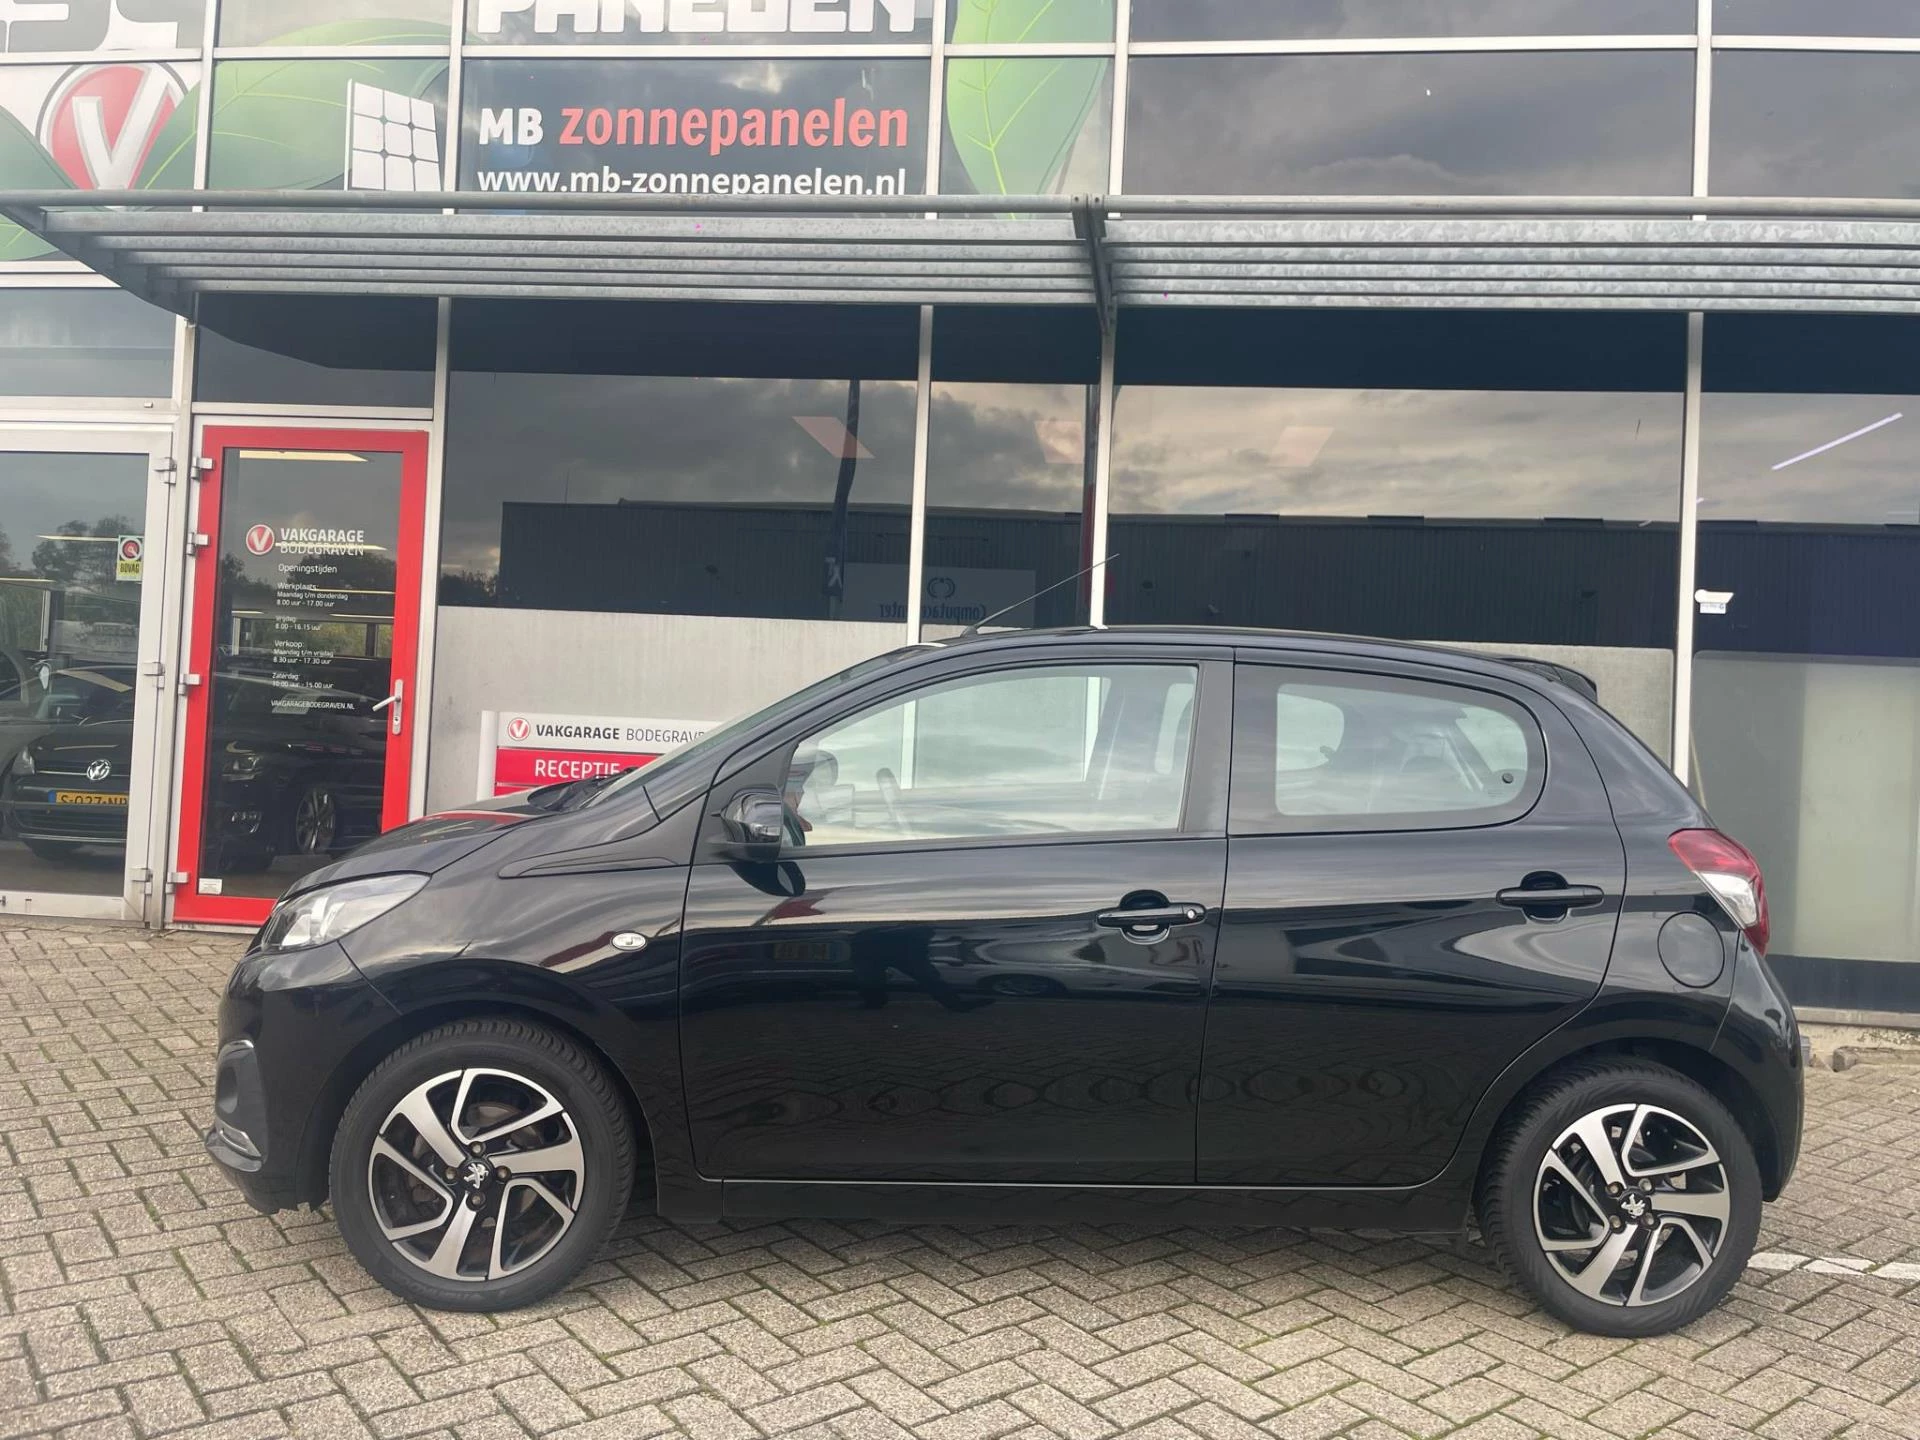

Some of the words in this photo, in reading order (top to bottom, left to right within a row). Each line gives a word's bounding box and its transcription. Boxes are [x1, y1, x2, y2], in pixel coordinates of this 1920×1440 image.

[479, 107, 544, 146] MB
[559, 97, 908, 157] zonnepanelen
[477, 165, 906, 195] www.mb-zonnepanelen.nl
[280, 528, 365, 543] VAKGARAGE
[280, 541, 365, 556] BODEGRAVEN
[278, 563, 338, 575] Openingstijden
[536, 724, 620, 740] VAKGARAGE
